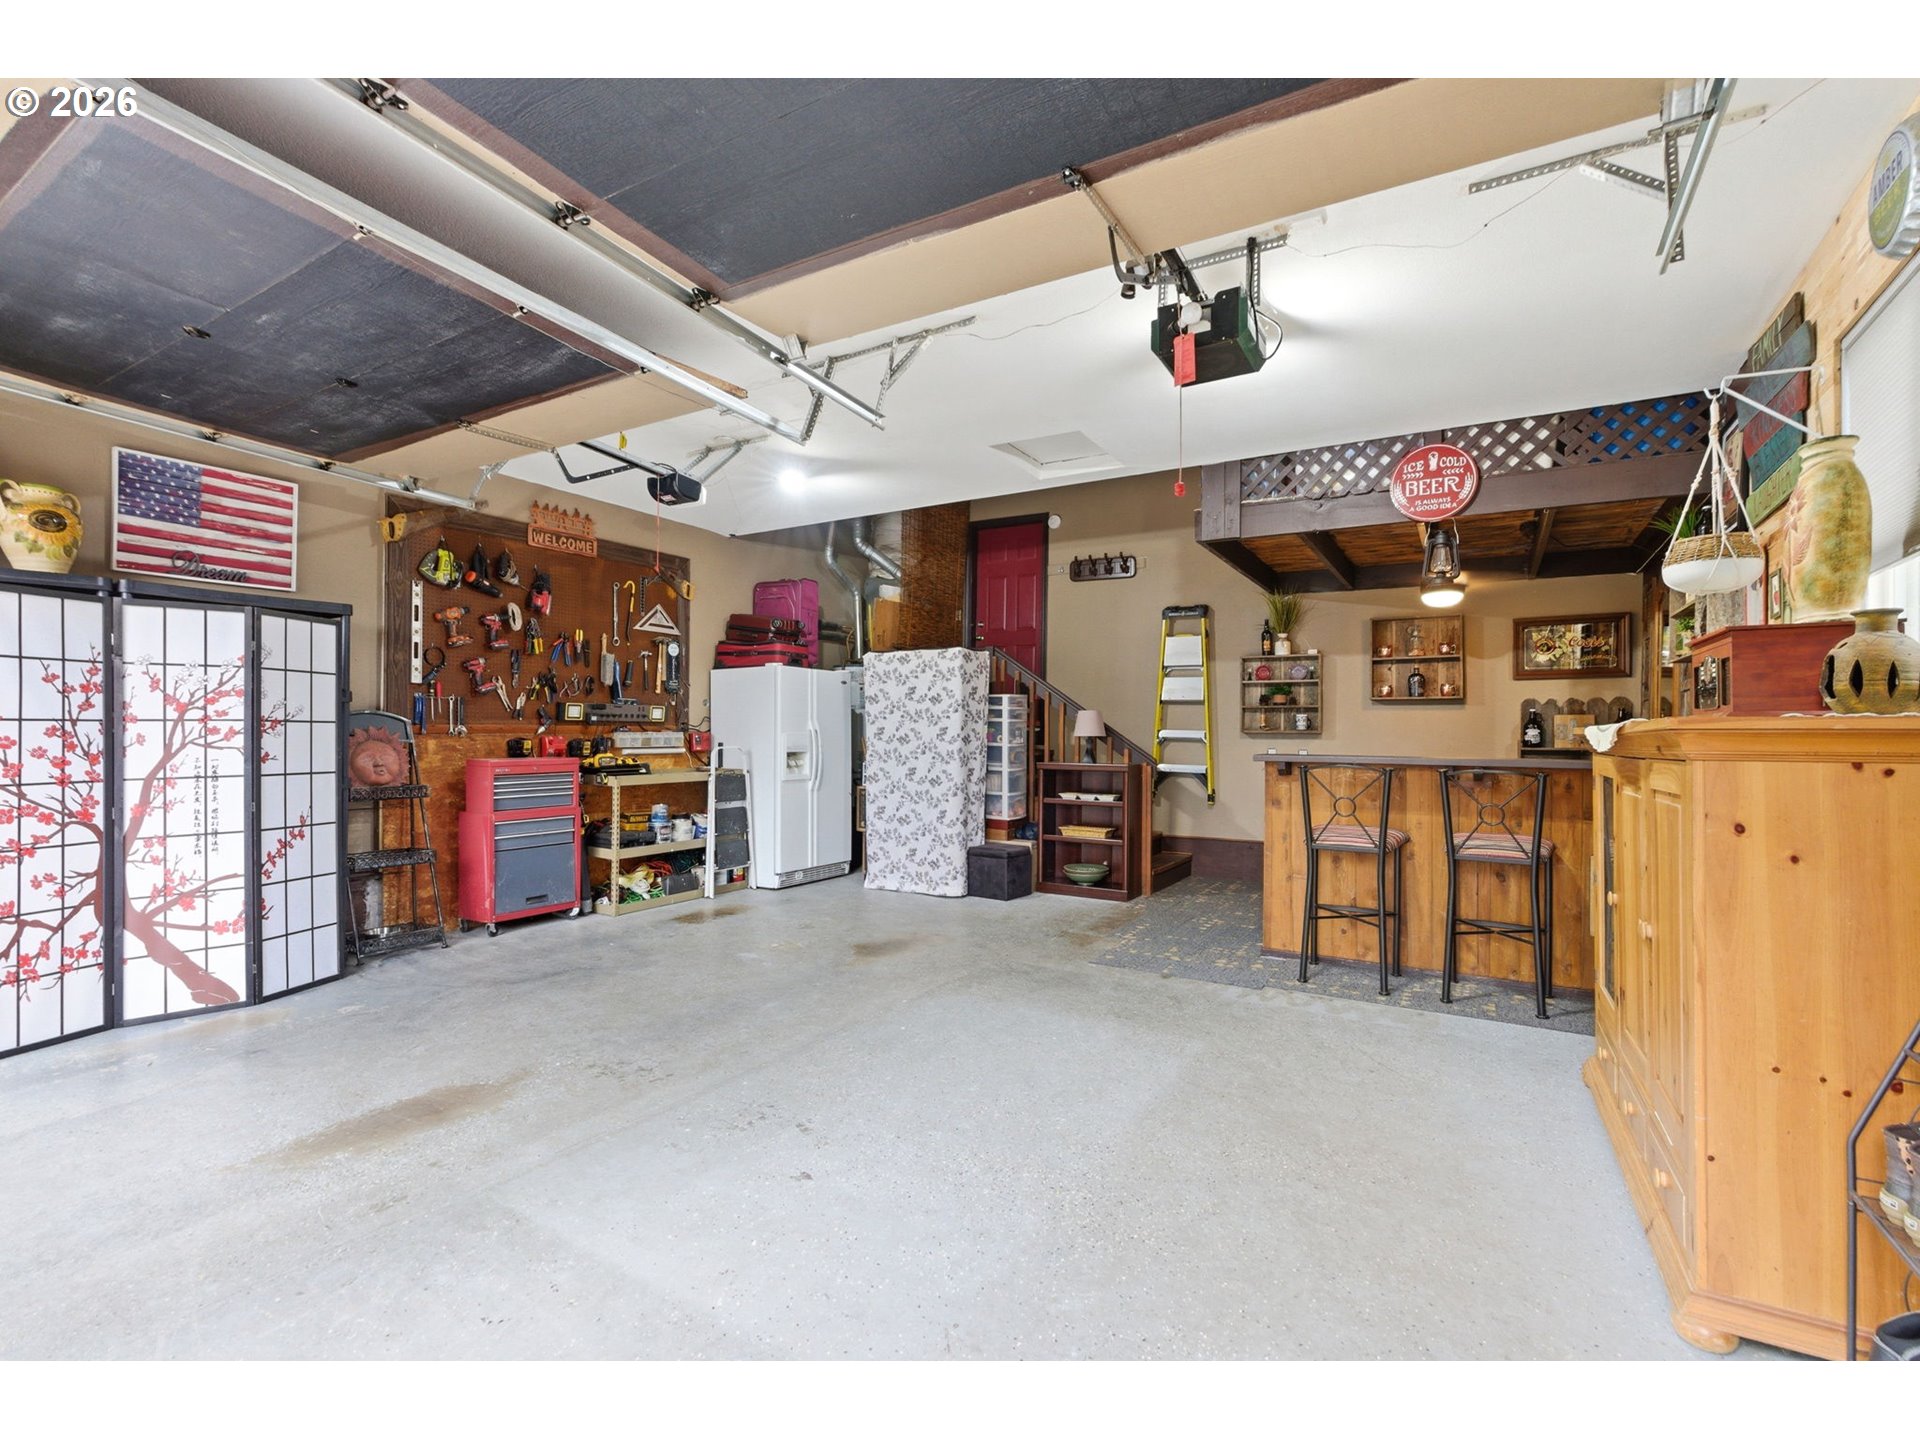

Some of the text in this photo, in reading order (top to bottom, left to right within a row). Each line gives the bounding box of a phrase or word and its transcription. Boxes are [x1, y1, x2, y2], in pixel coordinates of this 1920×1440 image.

[1872, 150, 1904, 206] AMBER
[1752, 310, 1785, 373] FAMILY
[1403, 456, 1467, 473] ICE COLD
[1405, 476, 1461, 497] BEER
[1416, 503, 1439, 512] GOOD
[1439, 502, 1458, 510] IDEA
[533, 531, 593, 553] WELCOME
[171, 550, 248, 582] Dream
